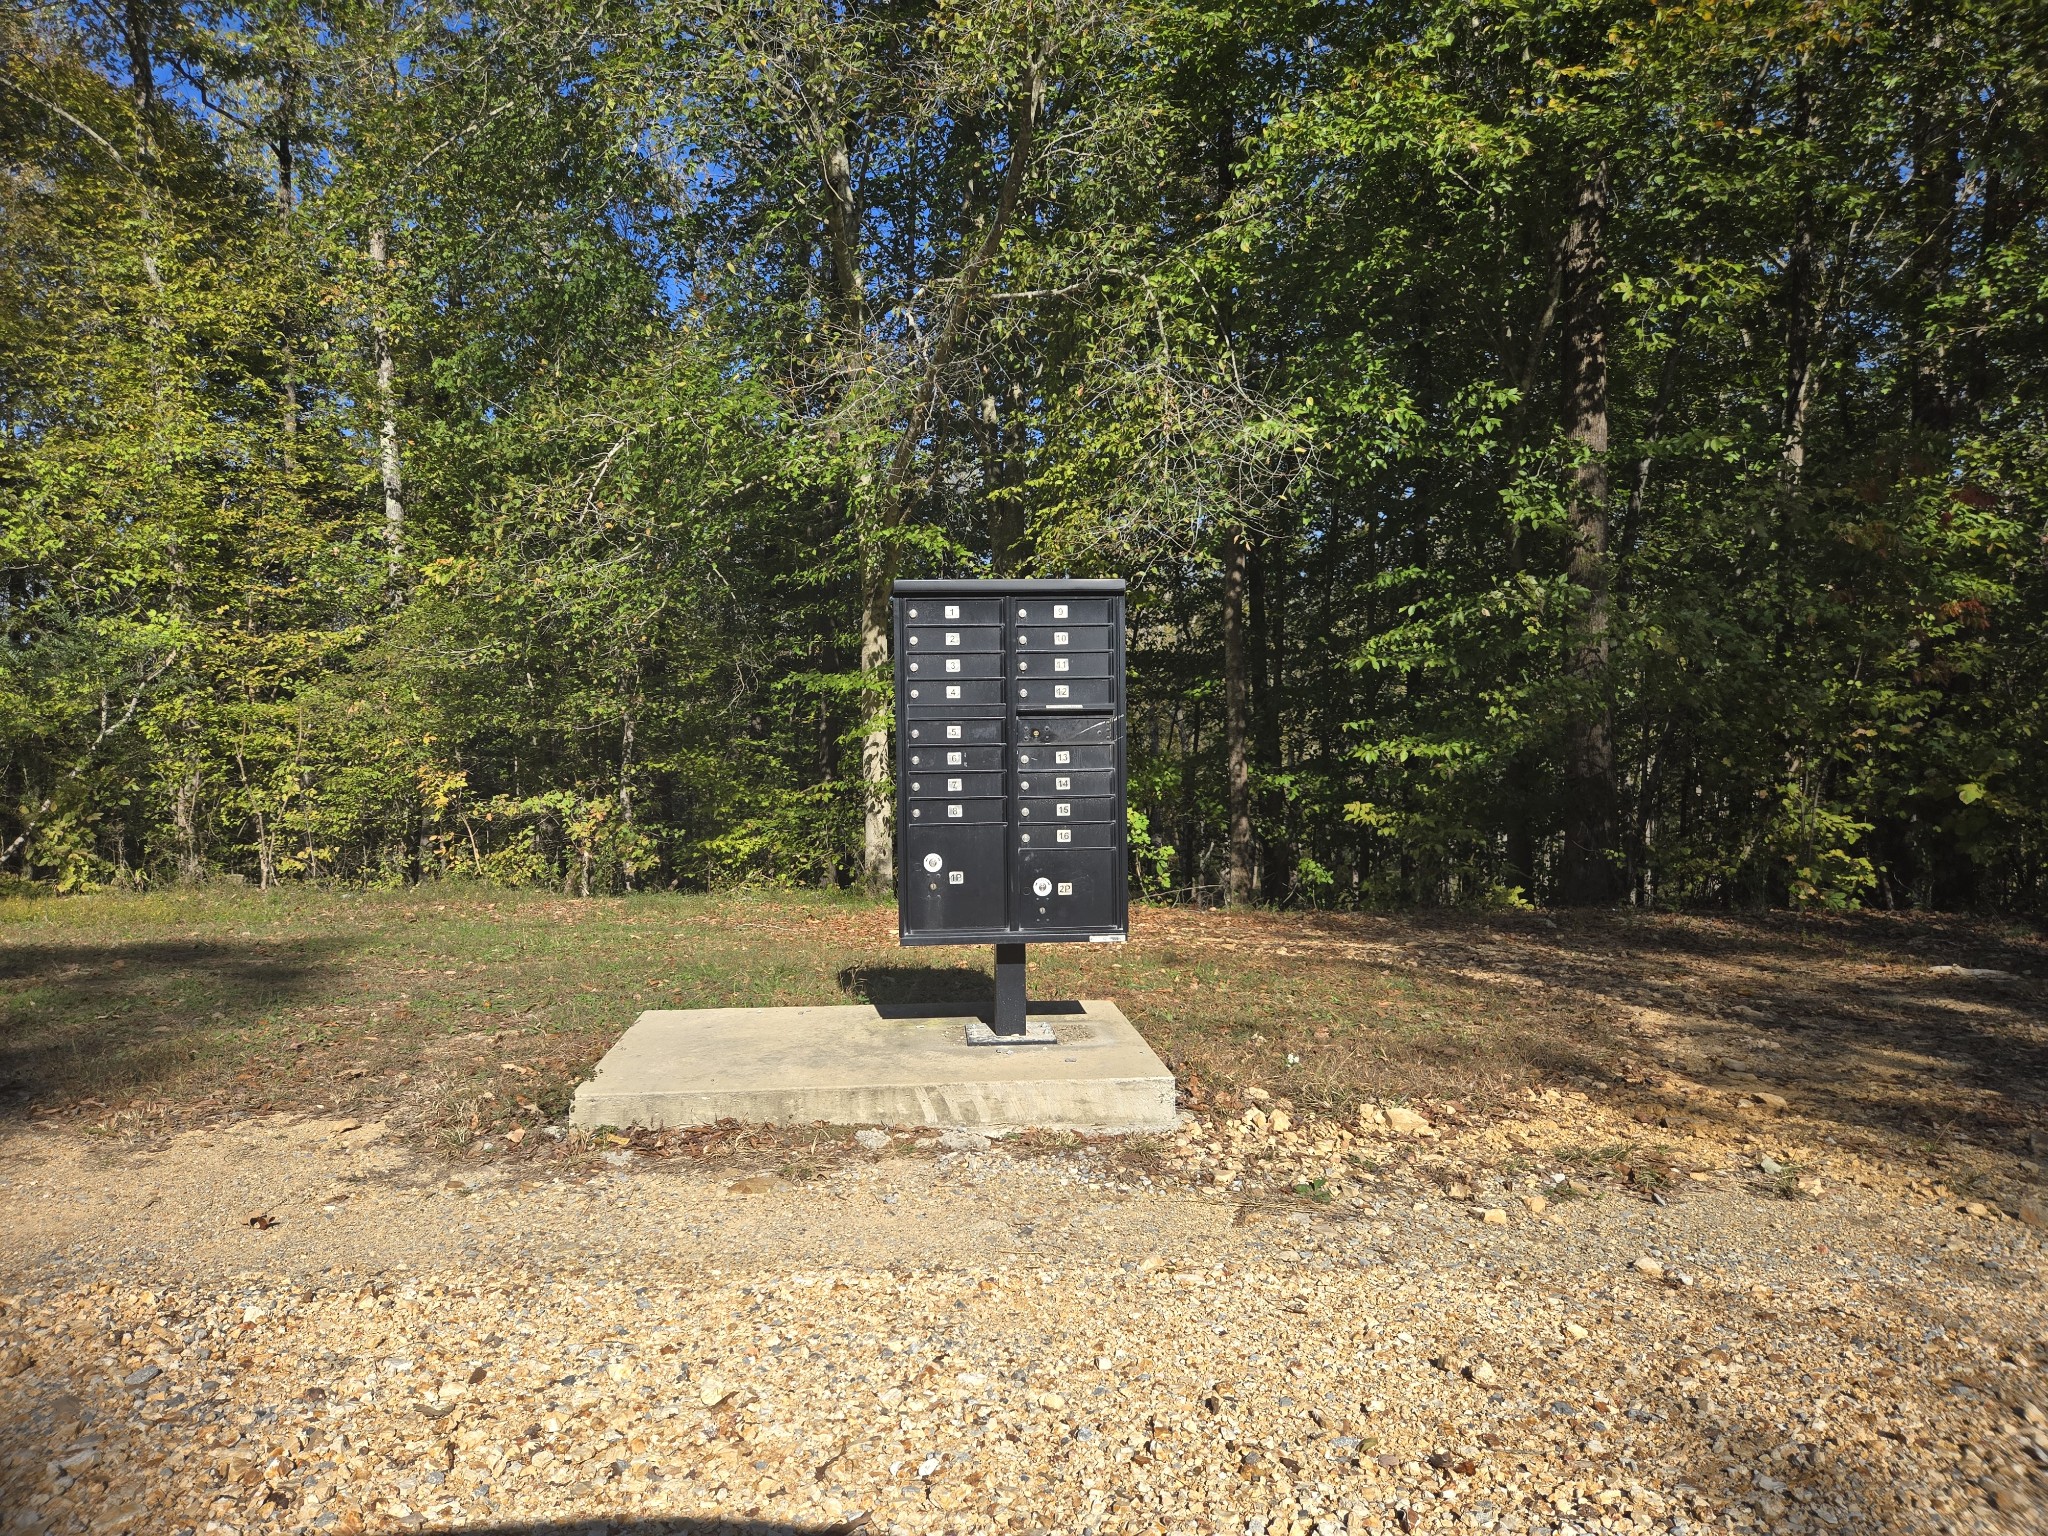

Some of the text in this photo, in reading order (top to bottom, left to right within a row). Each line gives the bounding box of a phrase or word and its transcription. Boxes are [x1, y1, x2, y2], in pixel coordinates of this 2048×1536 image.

[950, 635, 956, 643] 2
[950, 661, 956, 670] 3
[1056, 687, 1067, 696] 12
[951, 728, 957, 736] 5
[951, 754, 957, 762] 6
[1058, 753, 1068, 761] 13
[1058, 780, 1068, 788] 14
[1058, 806, 1069, 814] 15
[1059, 832, 1070, 840] 16
[950, 873, 962, 882] 1P
[1059, 884, 1071, 893] 2P
